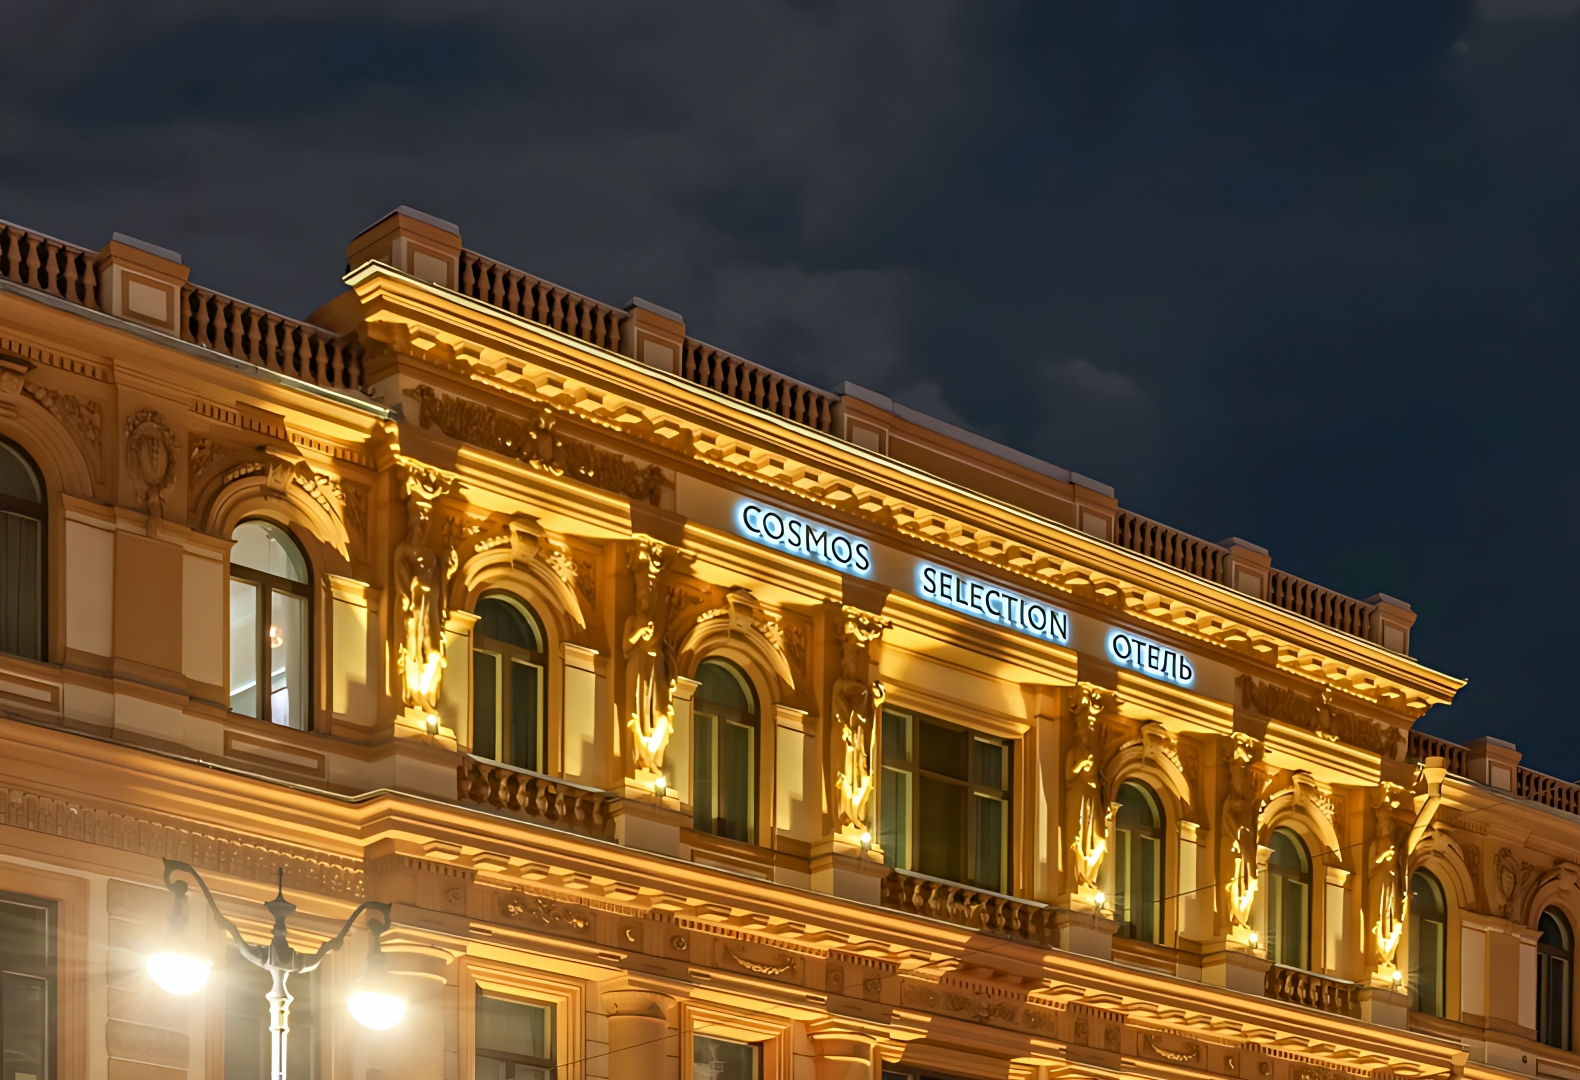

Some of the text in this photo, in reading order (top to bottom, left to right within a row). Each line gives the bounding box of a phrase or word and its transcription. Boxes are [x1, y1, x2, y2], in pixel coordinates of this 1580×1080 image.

[741, 504, 1069, 641] COSMOS SELECTION
[1111, 633, 1194, 682] ОТЕЛЬ
